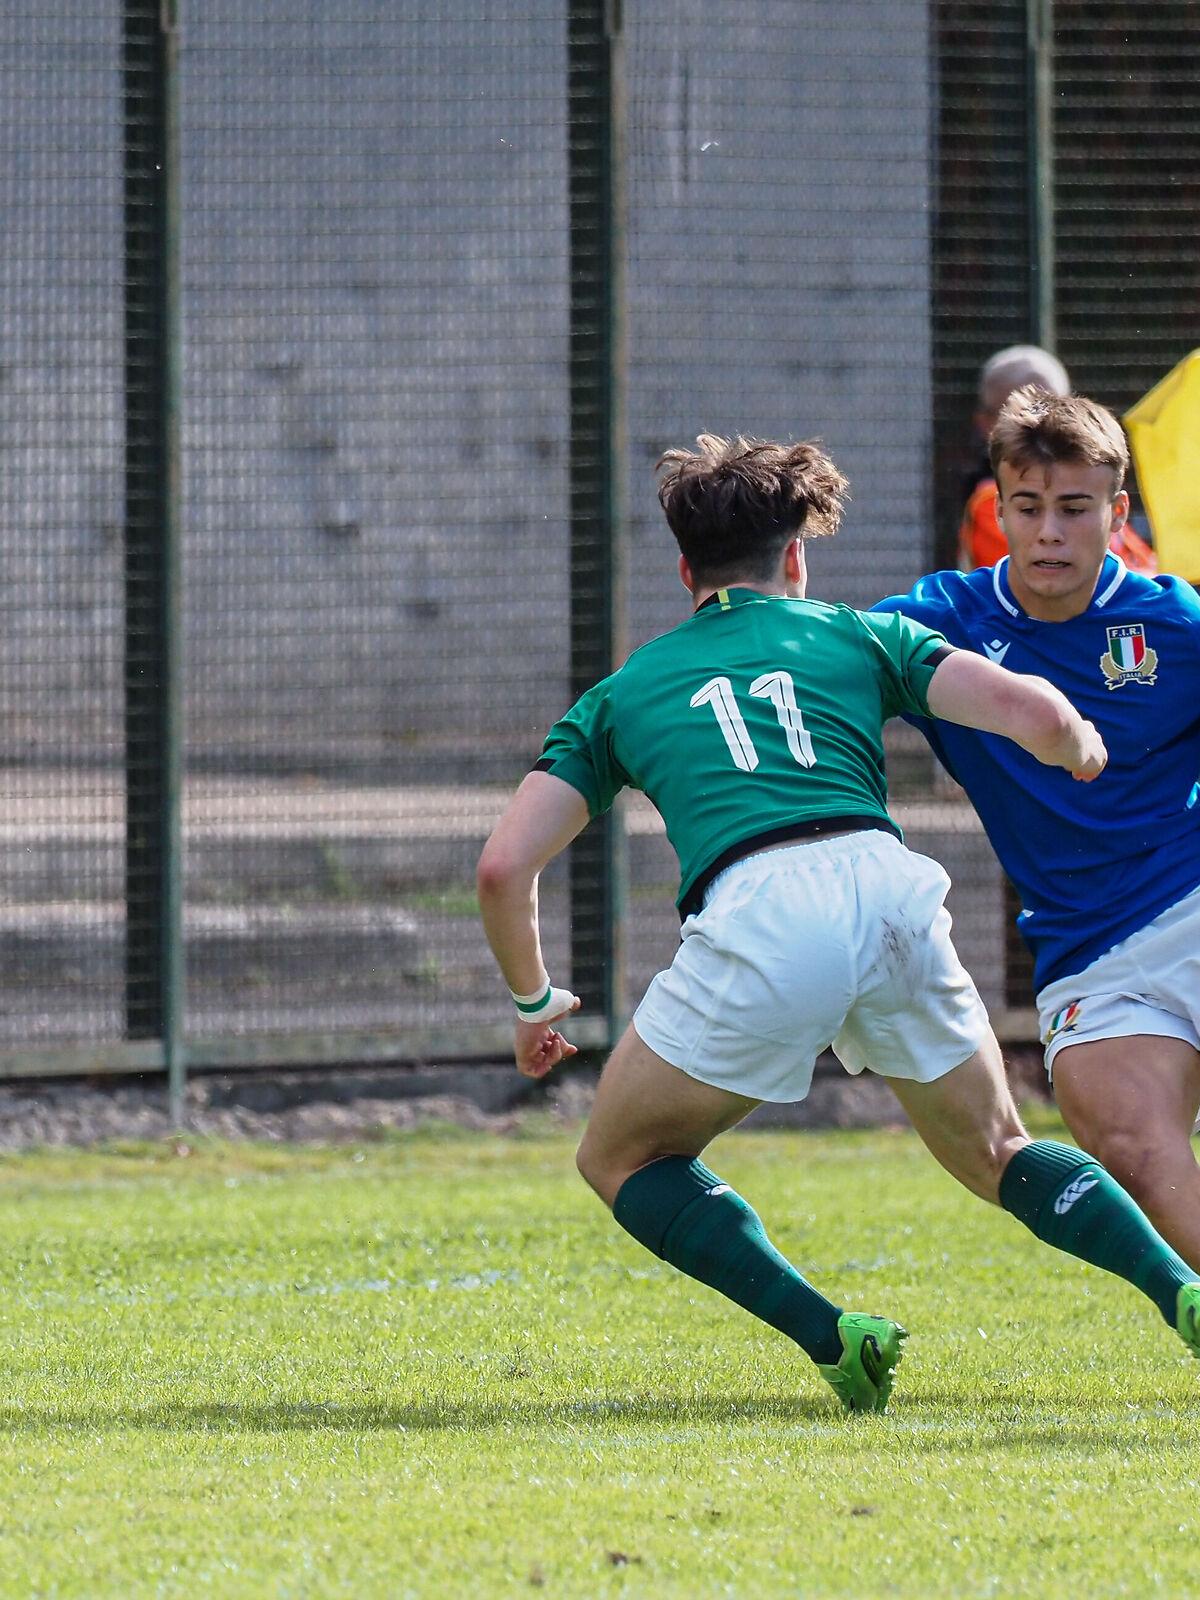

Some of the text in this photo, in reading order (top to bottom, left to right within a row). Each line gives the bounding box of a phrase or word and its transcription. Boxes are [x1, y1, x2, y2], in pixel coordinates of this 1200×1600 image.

[1111, 627, 1141, 637] F.I.R.
[1119, 672, 1142, 680] ITALIA
[689, 670, 818, 772] 11
